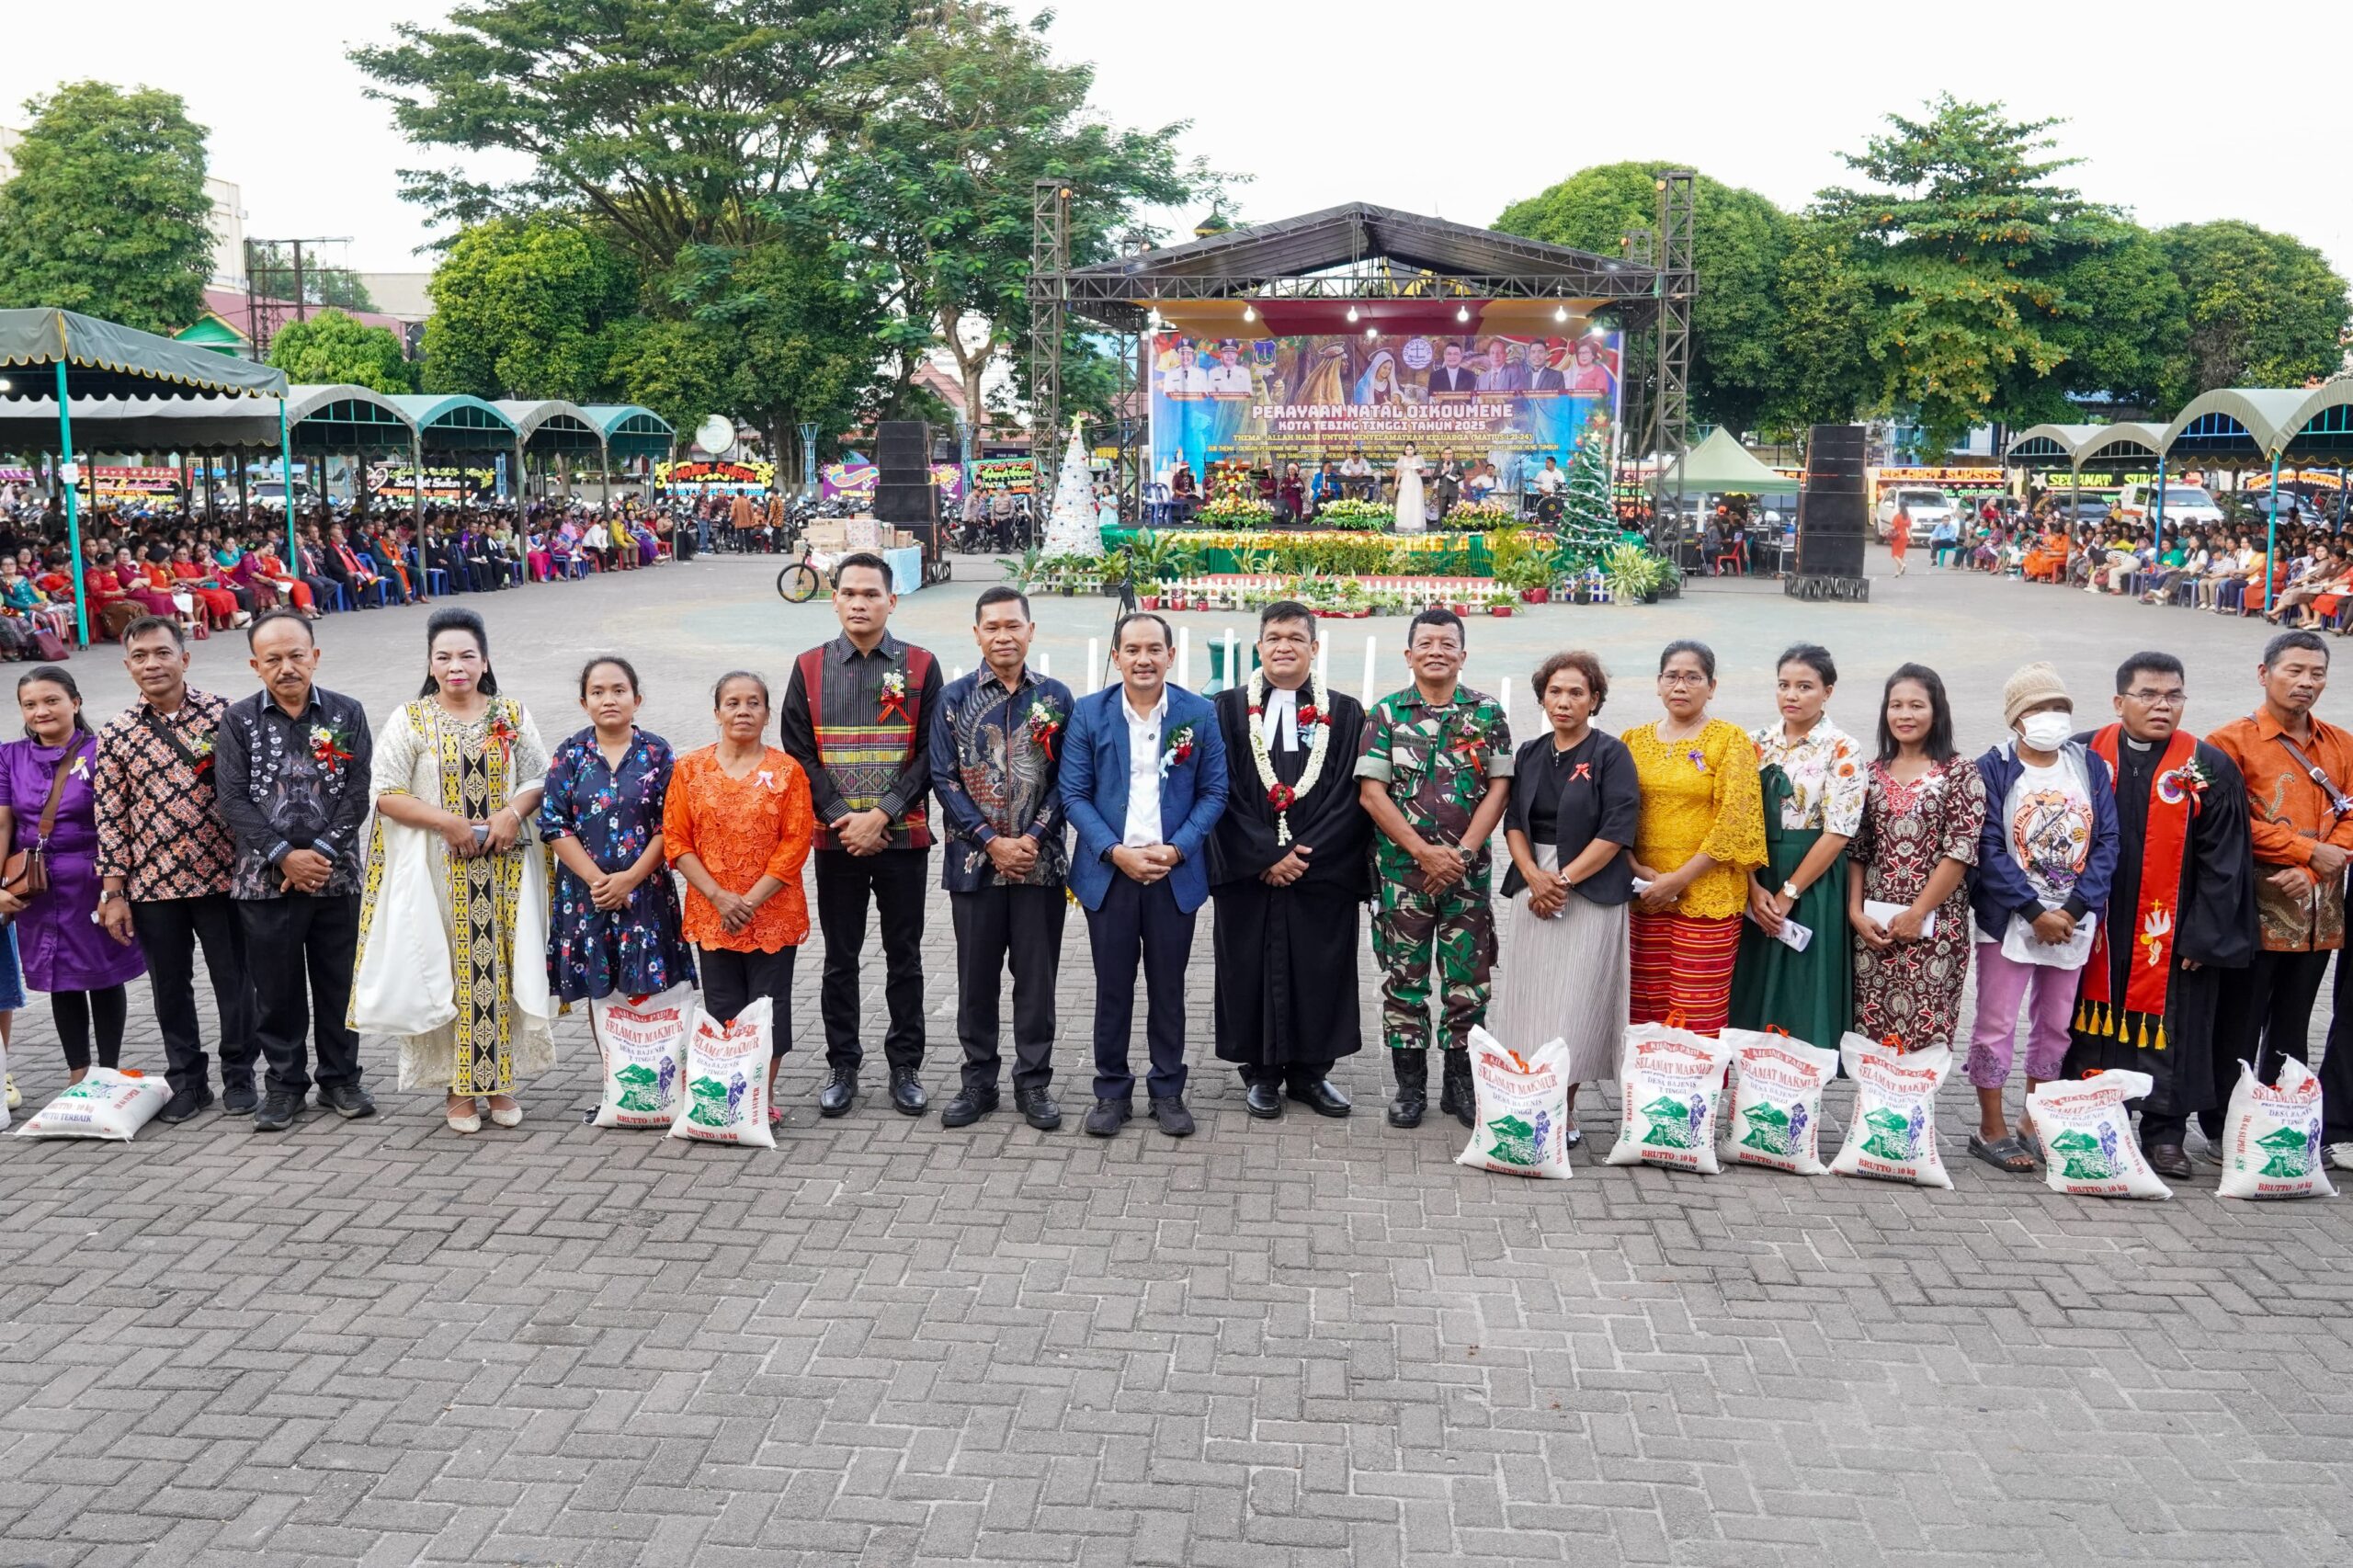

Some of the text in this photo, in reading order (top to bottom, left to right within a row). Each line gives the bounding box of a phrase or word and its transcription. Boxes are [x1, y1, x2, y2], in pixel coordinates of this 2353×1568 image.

[1252, 403, 1514, 419] PERAYAAN NATAL OIKOUMENE
[1279, 420, 1486, 431] KOTA TEBING TINGGI TAHUN 2025
[1880, 469, 2002, 479] SELAMAT SUKSES
[606, 1018, 642, 1044] SELAMAT
[644, 1020, 684, 1043] MAKMUR
[1679, 1045, 1699, 1056] PADI
[1753, 1049, 1783, 1062] KILANG
[1635, 1057, 1674, 1074] SELAMAT
[1675, 1062, 1714, 1075] MAKMUR
[1740, 1058, 1778, 1080] SELAMAT
[1781, 1072, 1820, 1087] MAKMUR
[1478, 1064, 1516, 1095] SELAMAT
[1518, 1074, 1558, 1095] MAKMUR
[1648, 1076, 1697, 1088] DESA BAJENIS
[1859, 1066, 1896, 1090] SELAMAT
[1767, 1095, 1789, 1104] TINGGI
[61, 1113, 92, 1122] TERBAIK
[617, 1114, 648, 1124] BRUTTO
[661, 1114, 670, 1123] kg
[687, 1126, 715, 1139] BRUTTO
[728, 1132, 737, 1141] kg
[2237, 1131, 2247, 1154] SUPER
[1642, 1150, 1675, 1160] BRUTTO
[1688, 1154, 1698, 1164] kg
[1740, 1152, 1772, 1165] BRUTTO
[1786, 1162, 1796, 1170] kg
[1486, 1162, 1518, 1175] BRUTTO
[1859, 1158, 1892, 1173] BRUTTO
[1906, 1167, 1916, 1177] kg
[2066, 1185, 2102, 1193] BRUTTO
[2257, 1182, 2291, 1191] BRUTTO
[2304, 1181, 2313, 1189] kg
